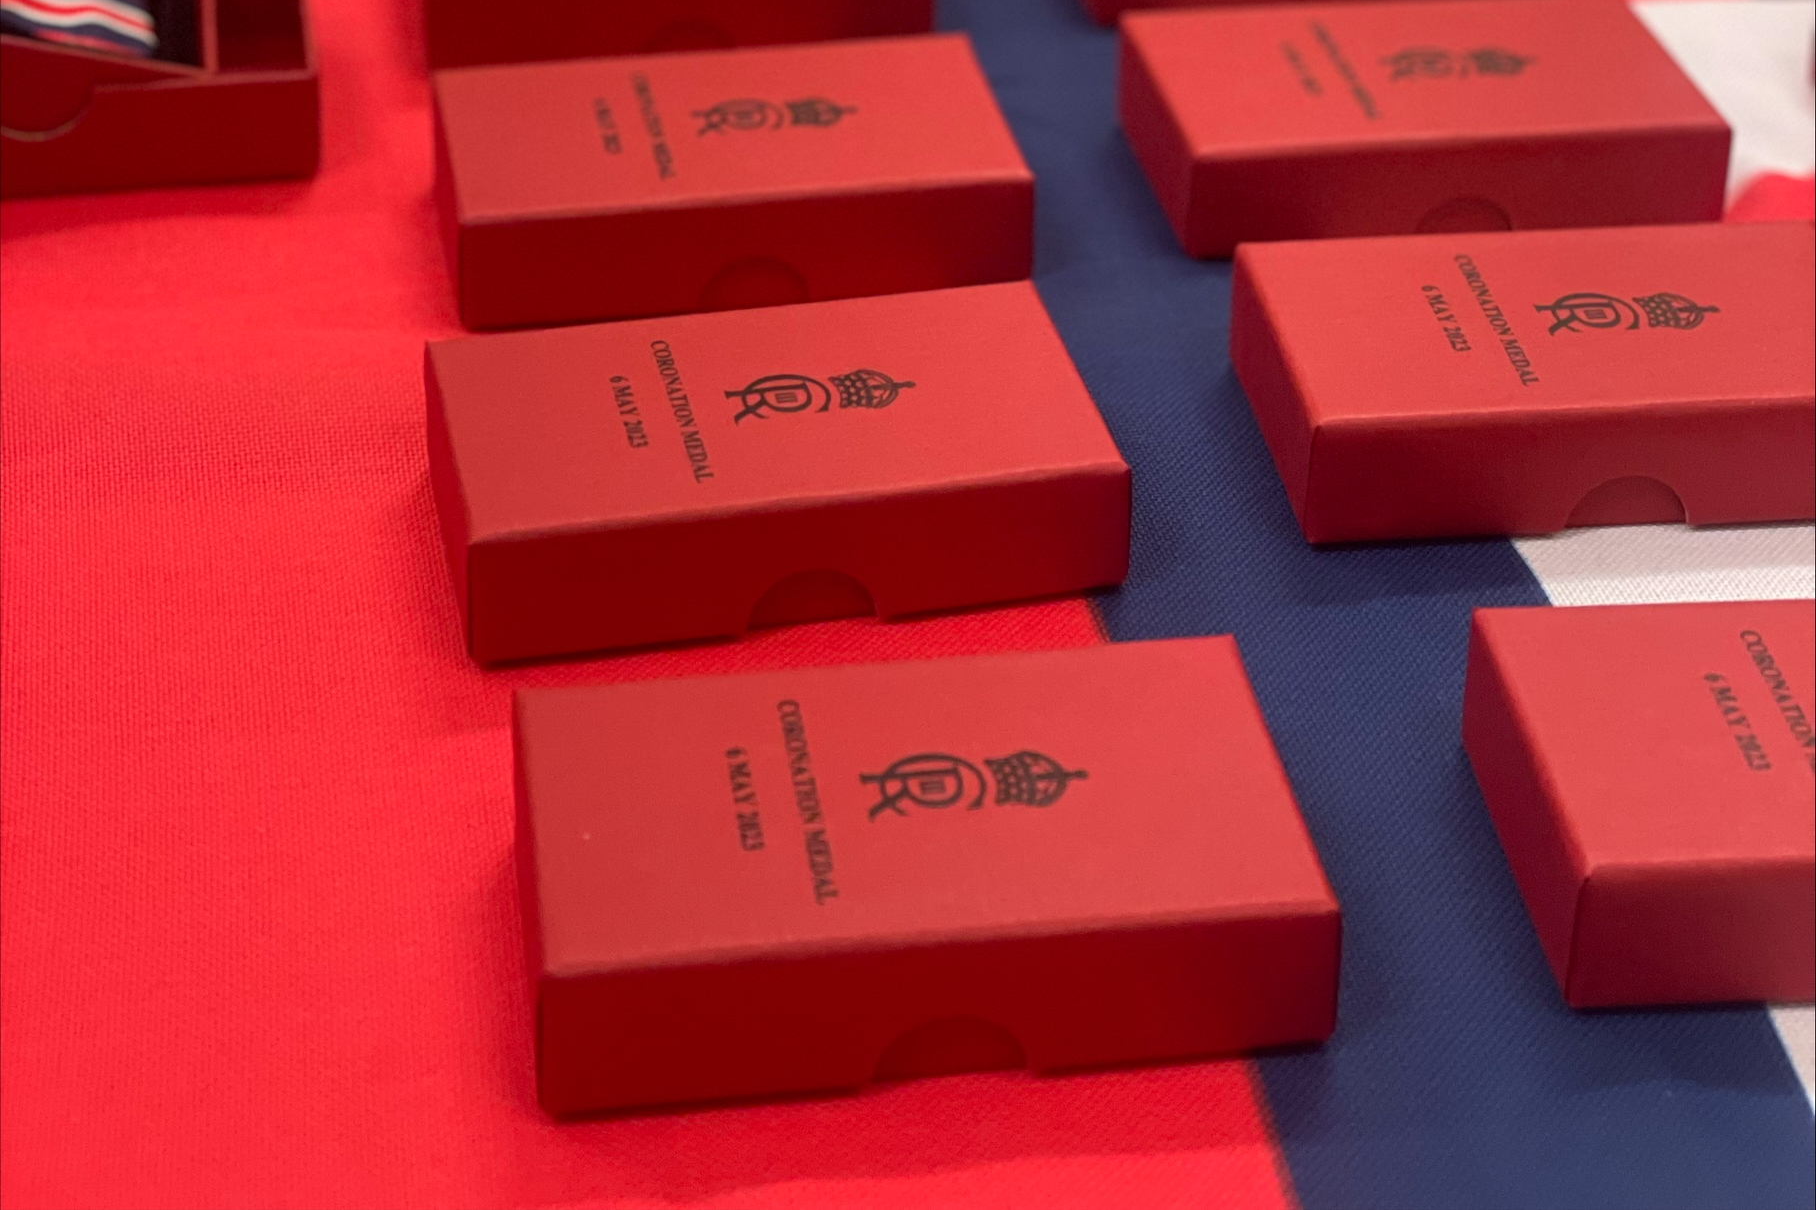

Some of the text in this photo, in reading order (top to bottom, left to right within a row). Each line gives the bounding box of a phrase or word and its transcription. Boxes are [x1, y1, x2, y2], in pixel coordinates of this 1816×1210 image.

[1424, 292, 1454, 326] MAY
[1443, 322, 1472, 353] 2023
[1454, 253, 1540, 387] CORONATION MEDAL
[611, 385, 638, 418] MAY
[650, 339, 714, 483] CORONATION MEDAL
[623, 418, 649, 449] 2023
[1709, 686, 1752, 729] MAY
[727, 759, 757, 809] MAY
[776, 698, 839, 906] CORONATION MEDAL
